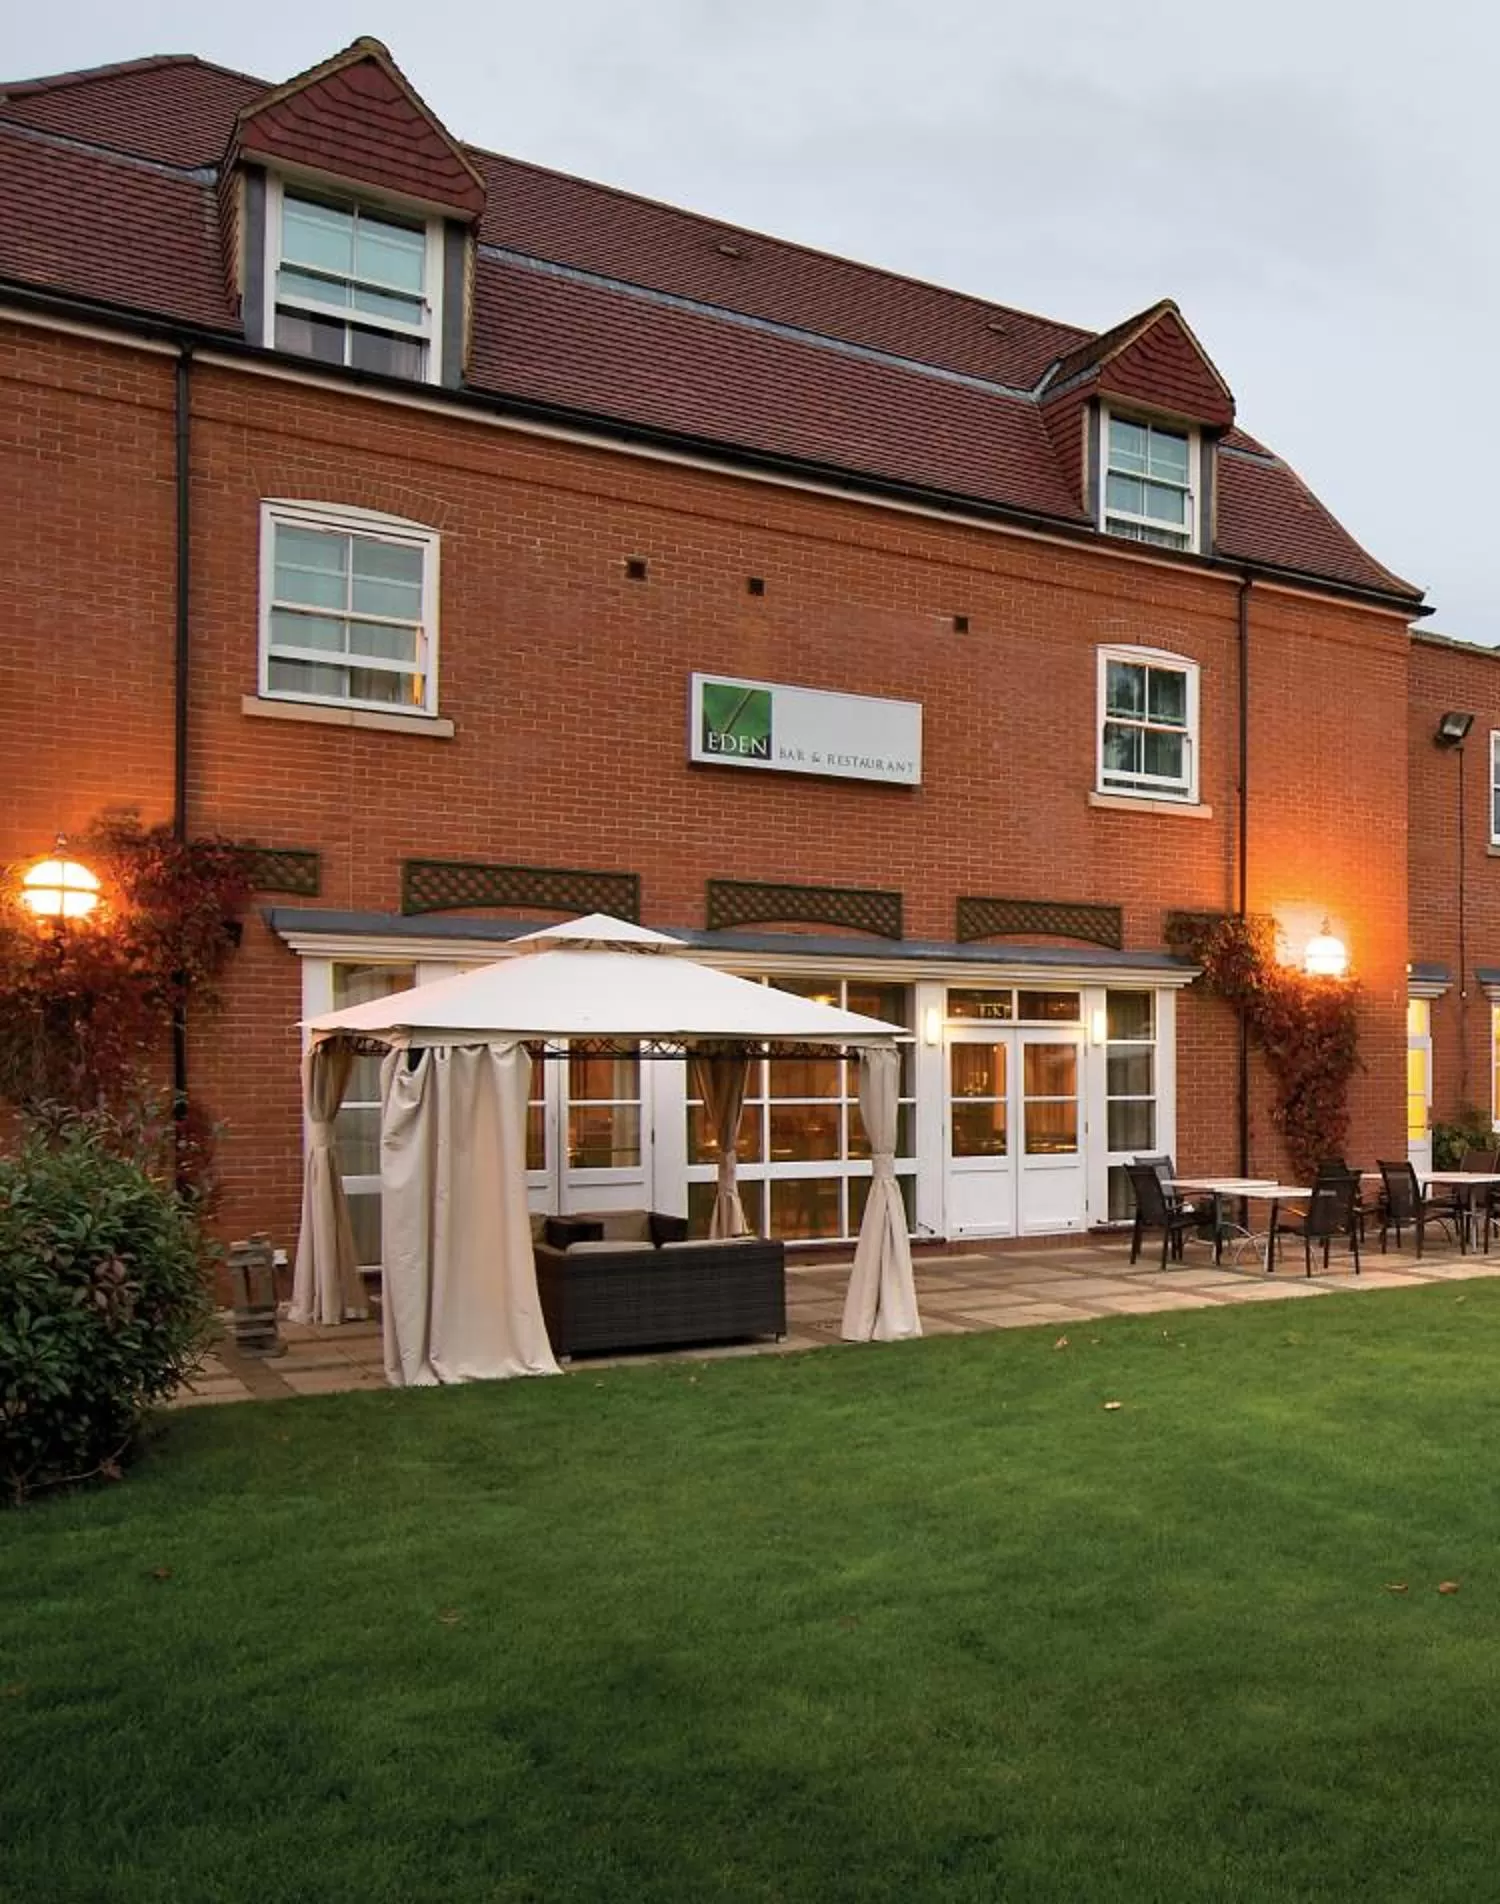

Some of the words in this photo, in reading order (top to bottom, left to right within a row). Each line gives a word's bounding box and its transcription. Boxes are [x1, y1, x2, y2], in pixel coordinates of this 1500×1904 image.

[707, 731, 768, 756] EDEN
[779, 747, 805, 762] BAR
[811, 751, 821, 763] &
[826, 753, 913, 773] RESTAURANT
